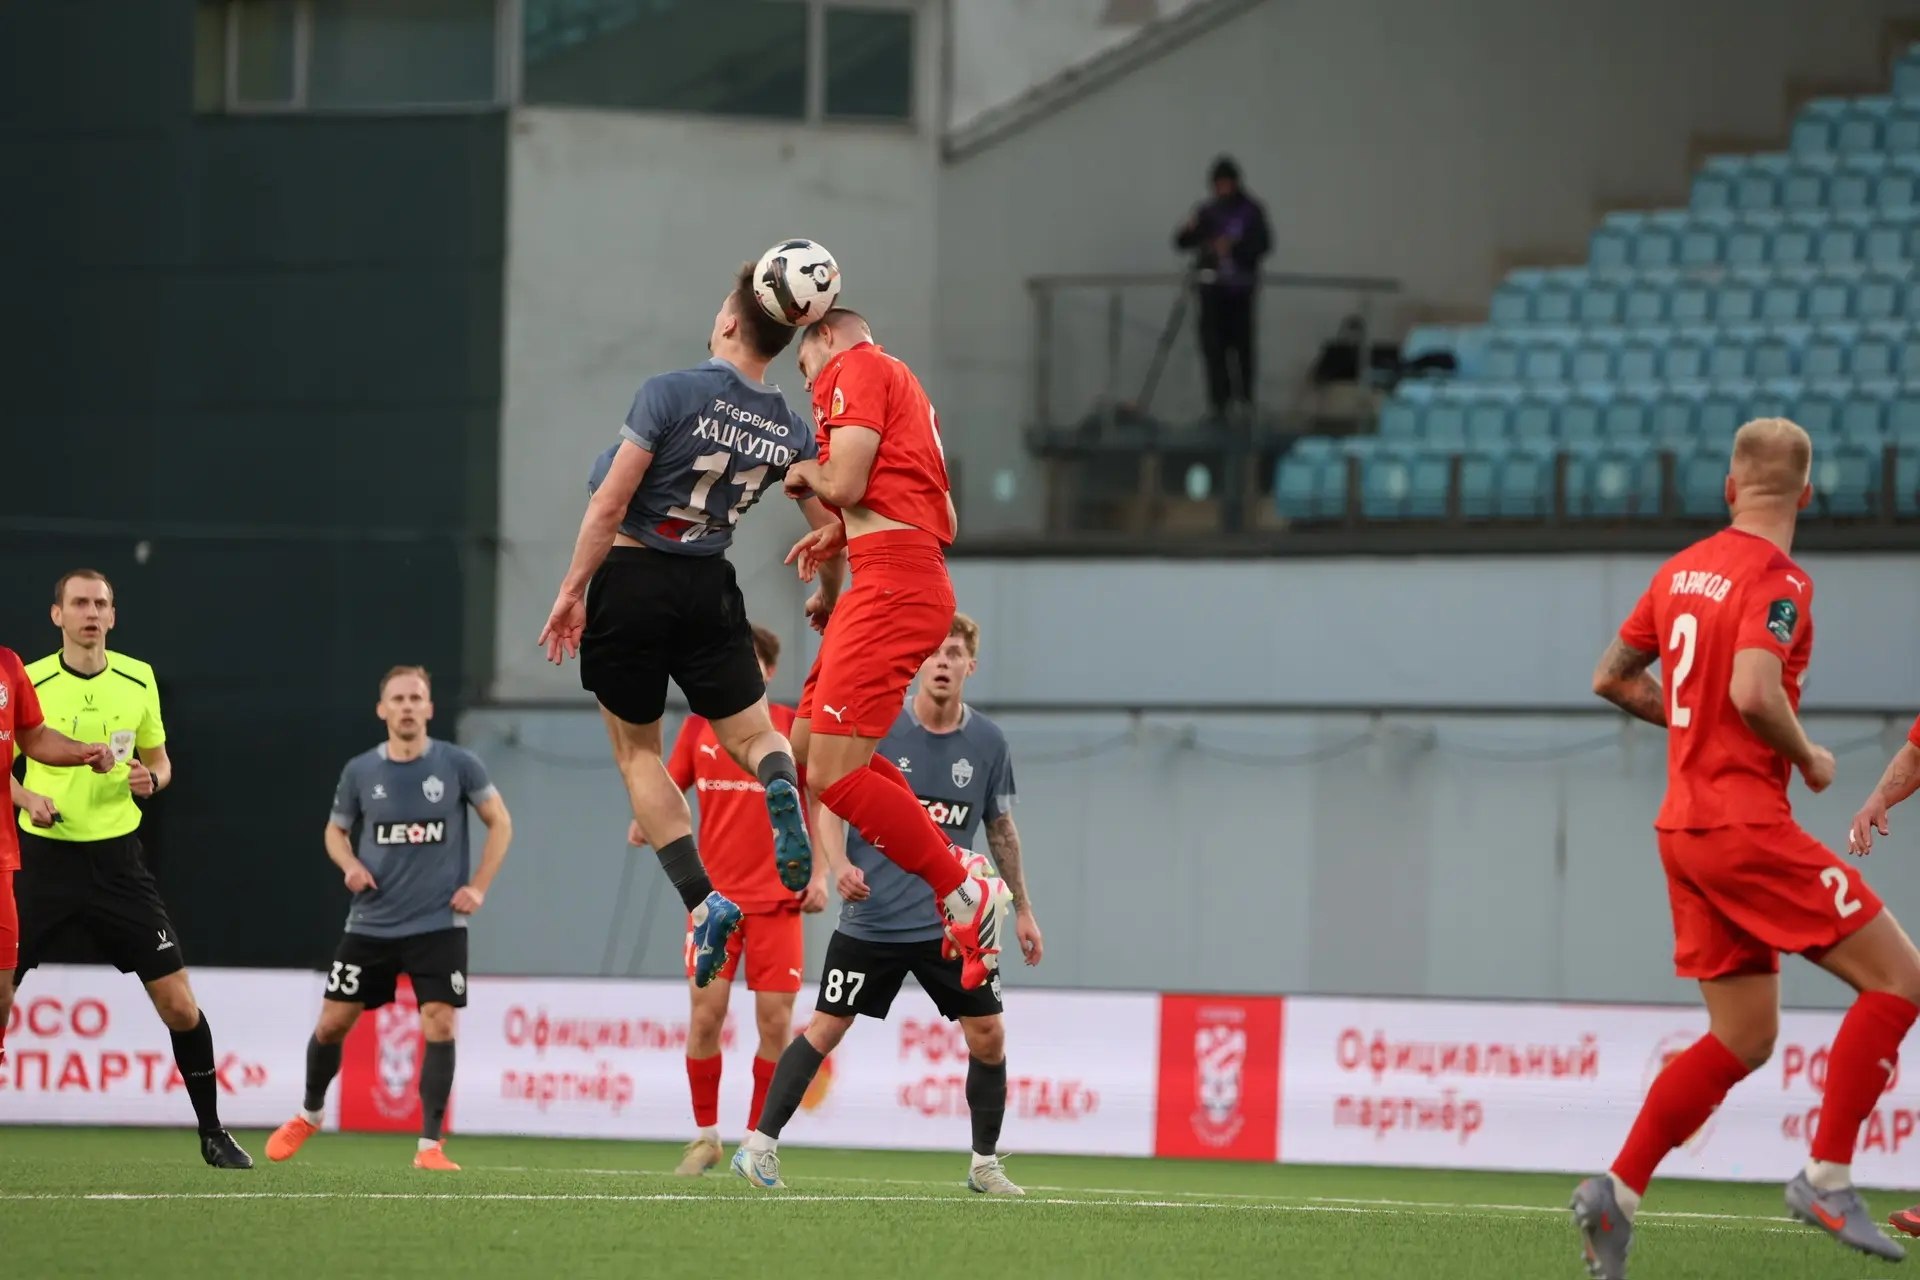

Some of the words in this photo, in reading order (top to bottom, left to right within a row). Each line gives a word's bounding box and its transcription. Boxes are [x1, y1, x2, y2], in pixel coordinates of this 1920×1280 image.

[666, 450, 769, 525] 11
[1669, 613, 1698, 728] 2
[376, 821, 444, 845] LEON
[1820, 867, 1862, 919] 2
[327, 960, 362, 996] 33
[824, 967, 866, 1006] 87
[504, 1004, 738, 1054] Официальнй
[1336, 1027, 1599, 1085] Официальный
[1334, 1087, 1484, 1146] партнёр
